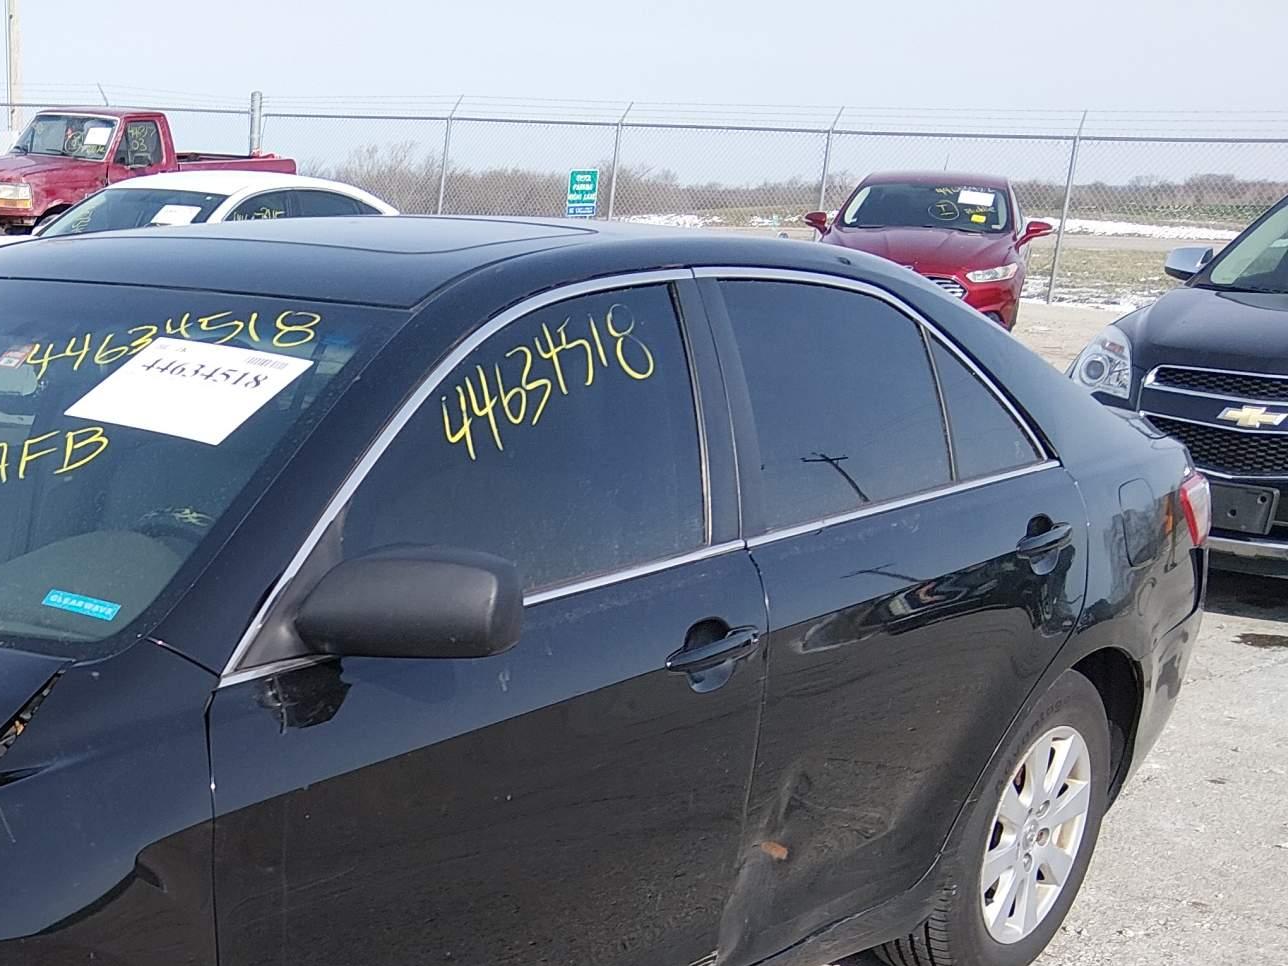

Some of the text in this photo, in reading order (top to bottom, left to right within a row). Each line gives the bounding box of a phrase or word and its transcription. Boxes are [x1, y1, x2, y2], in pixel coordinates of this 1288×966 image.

[26, 310, 322, 381] 44634518
[141, 357, 269, 389] 44634518
[440, 303, 655, 461] 44634518
